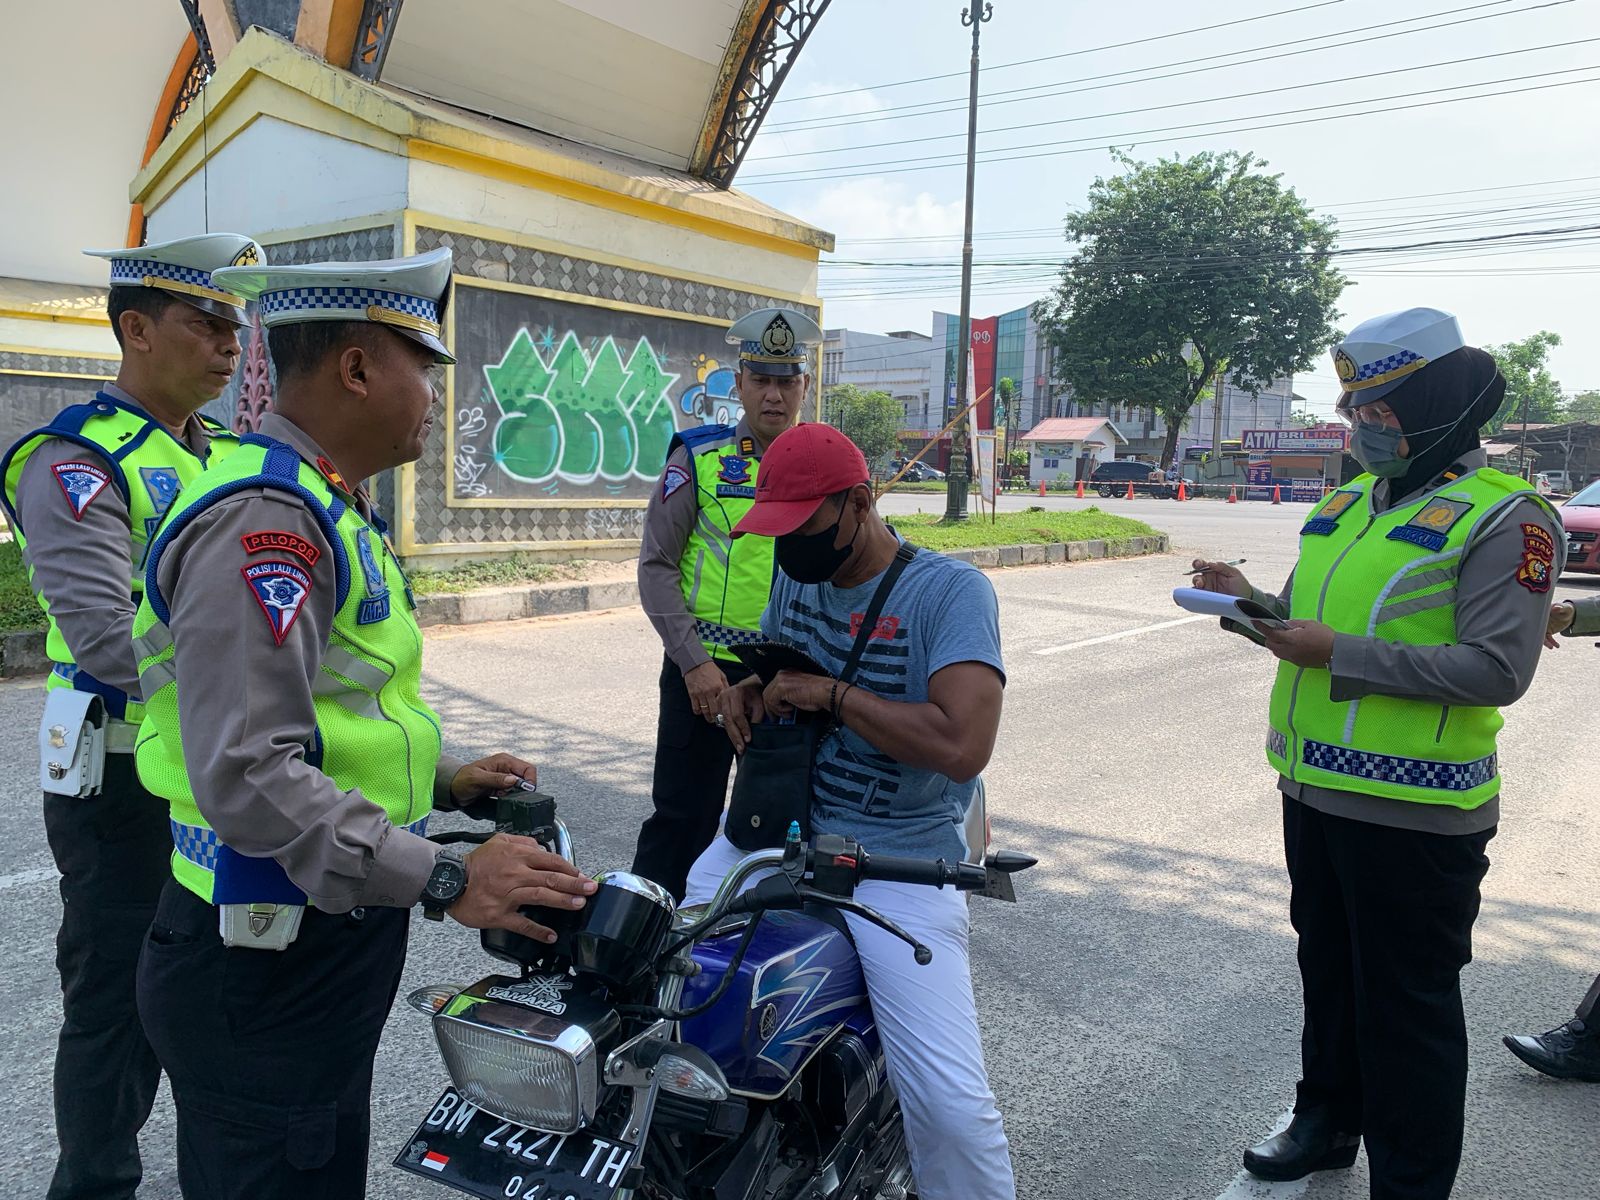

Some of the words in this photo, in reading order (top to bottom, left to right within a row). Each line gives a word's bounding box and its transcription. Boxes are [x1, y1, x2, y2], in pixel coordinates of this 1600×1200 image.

[1244, 432, 1276, 449] ATM
[56, 464, 75, 472] POLISI
[1526, 525, 1552, 545] POLDA
[251, 535, 314, 559] PELOPOR
[1529, 540, 1552, 556] RIAU
[247, 564, 271, 577] POLISI
[273, 564, 291, 575] LALU
[489, 988, 563, 1013] YAMAHA
[426, 1092, 479, 1133] BM
[580, 1138, 632, 1188] TH
